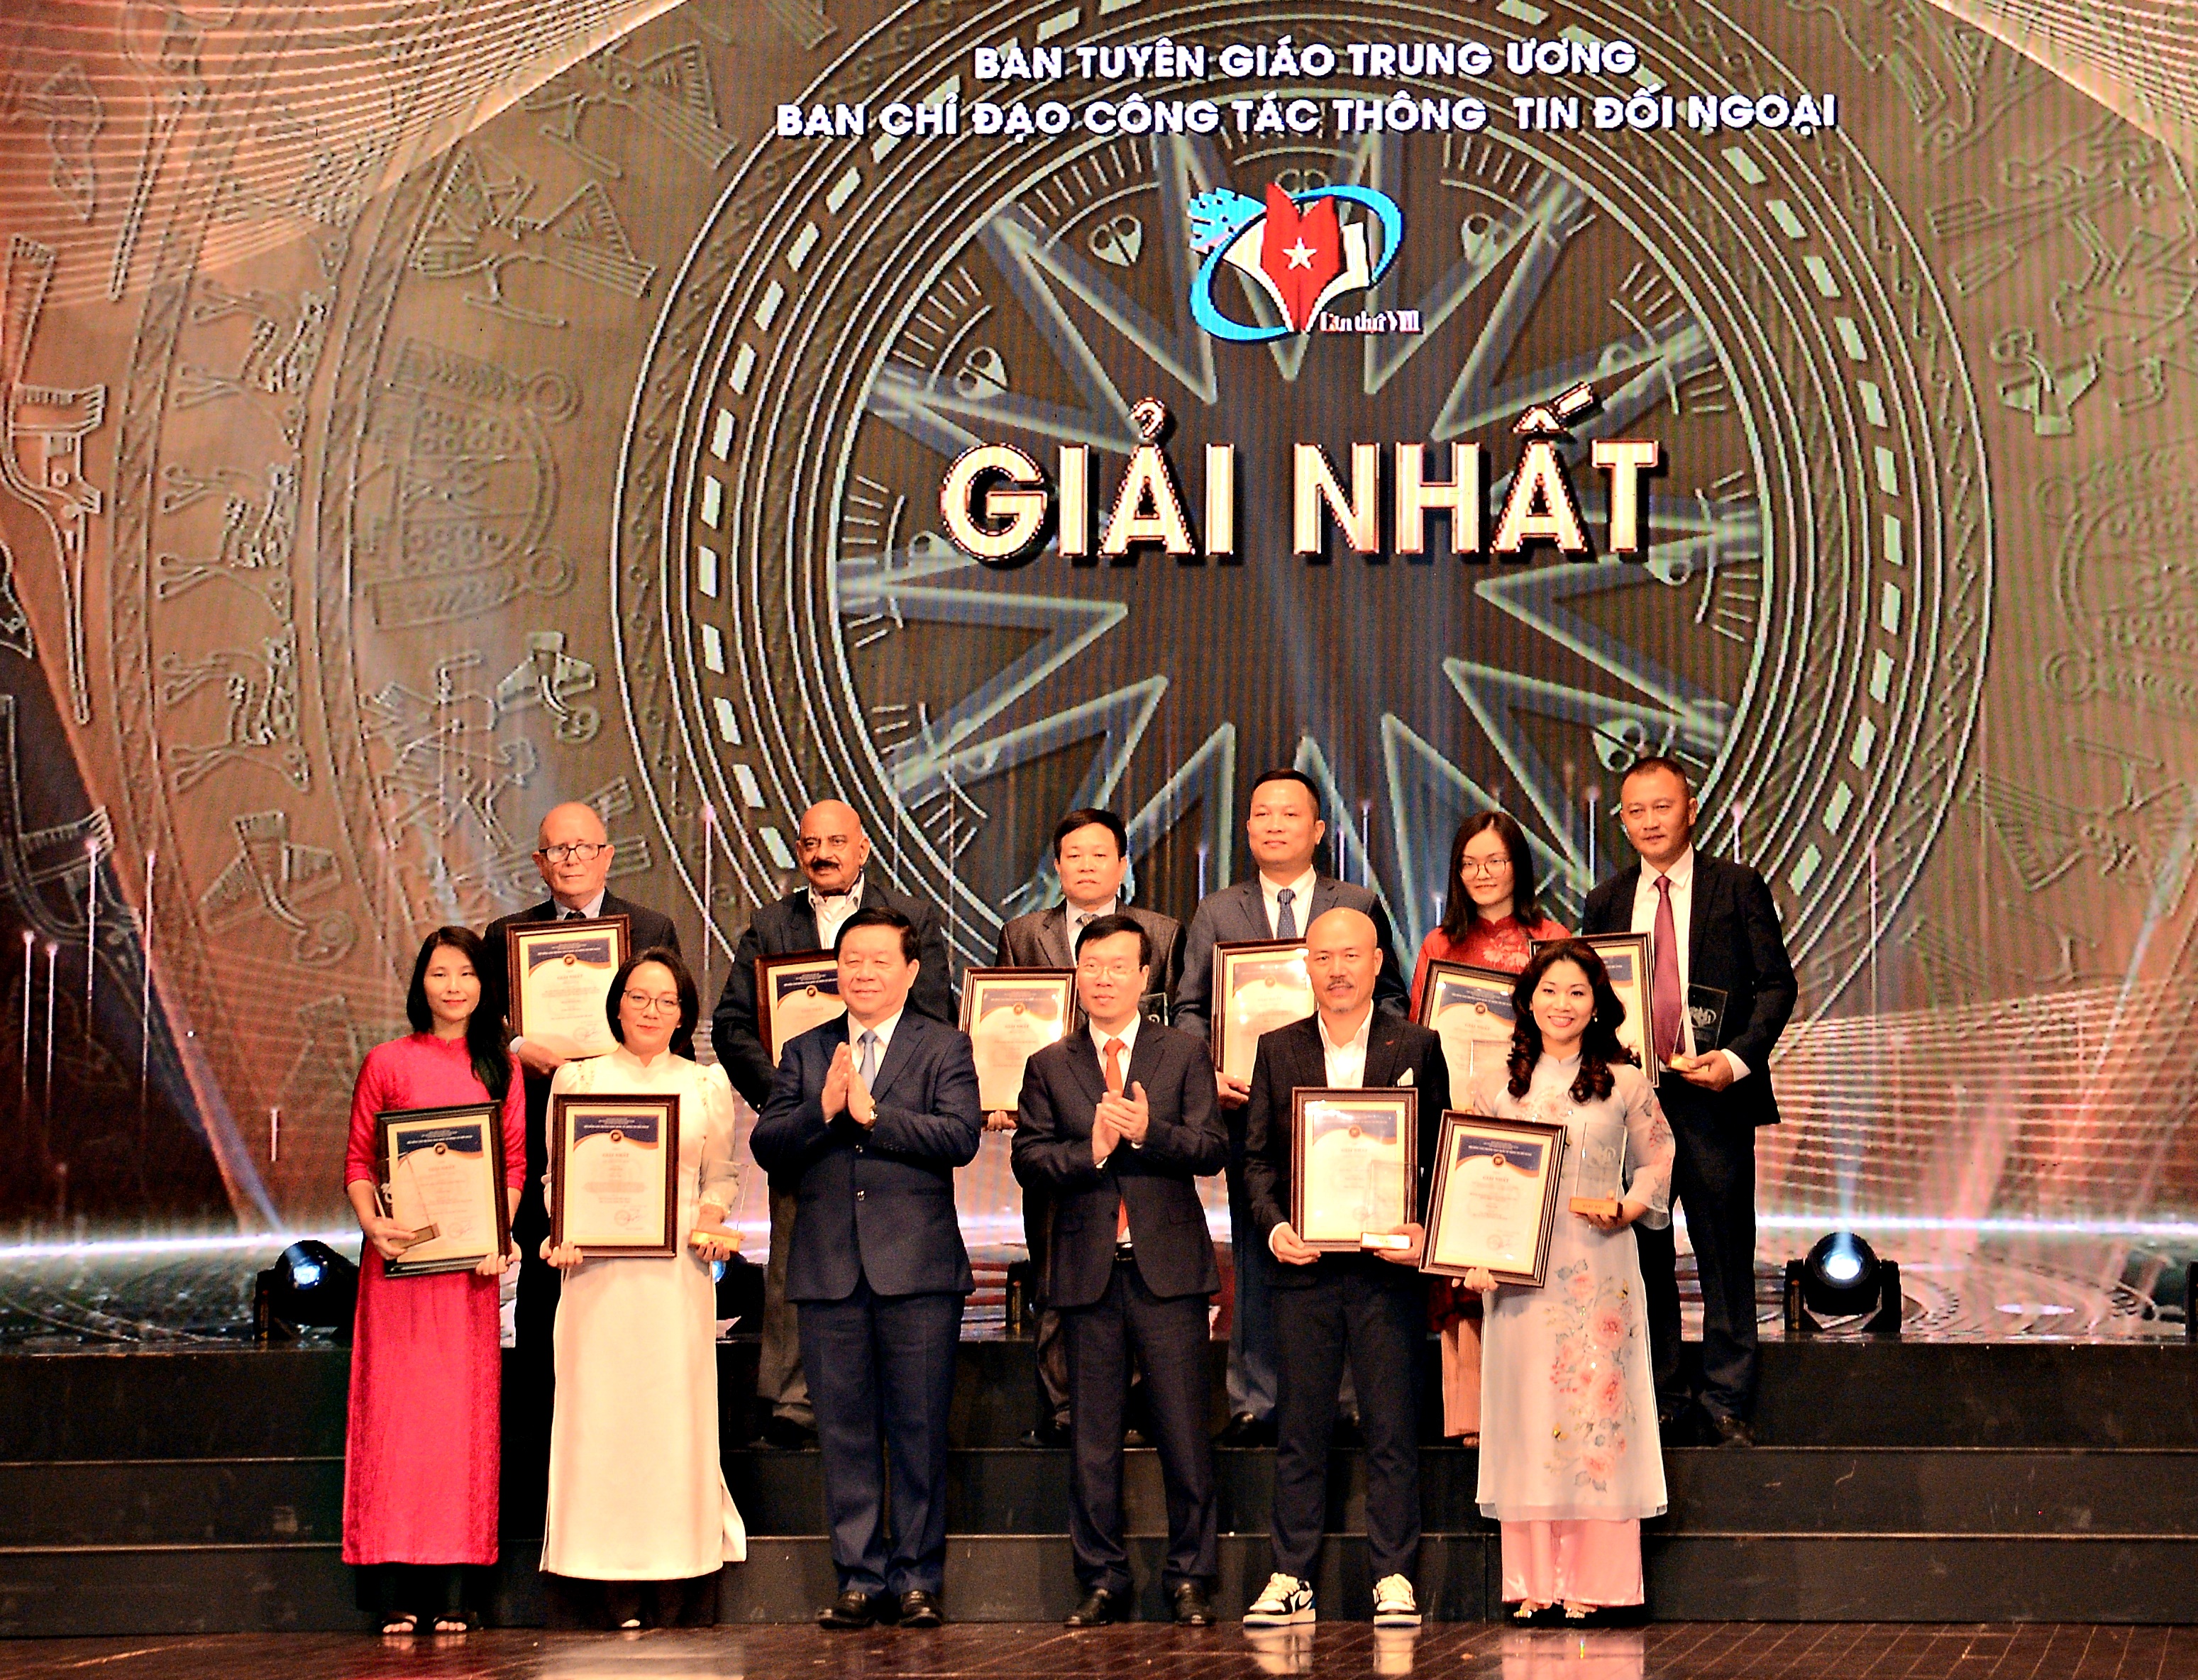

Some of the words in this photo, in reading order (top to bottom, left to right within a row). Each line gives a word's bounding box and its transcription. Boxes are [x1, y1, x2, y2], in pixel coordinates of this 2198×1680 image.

[974, 45, 1062, 79] BAN
[1076, 37, 1205, 78] TUYÊN
[1219, 34, 1335, 77] GIÁO
[1348, 41, 1492, 75] TRUNG
[1505, 37, 1637, 74] ƯƠNG
[776, 103, 864, 136] BAN
[878, 92, 958, 136] CHỈ
[971, 101, 1071, 143] ĐẠO
[1083, 92, 1219, 135] CÔNG
[1231, 92, 1321, 133] TÁC
[1332, 90, 1486, 132] THÔNG
[1513, 96, 1579, 130] TIN
[1593, 82, 1676, 130] ĐỐI
[1686, 93, 1836, 136] NGOẠI
[940, 395, 1235, 560] GIẢI
[1292, 381, 1660, 556] NHẤT
